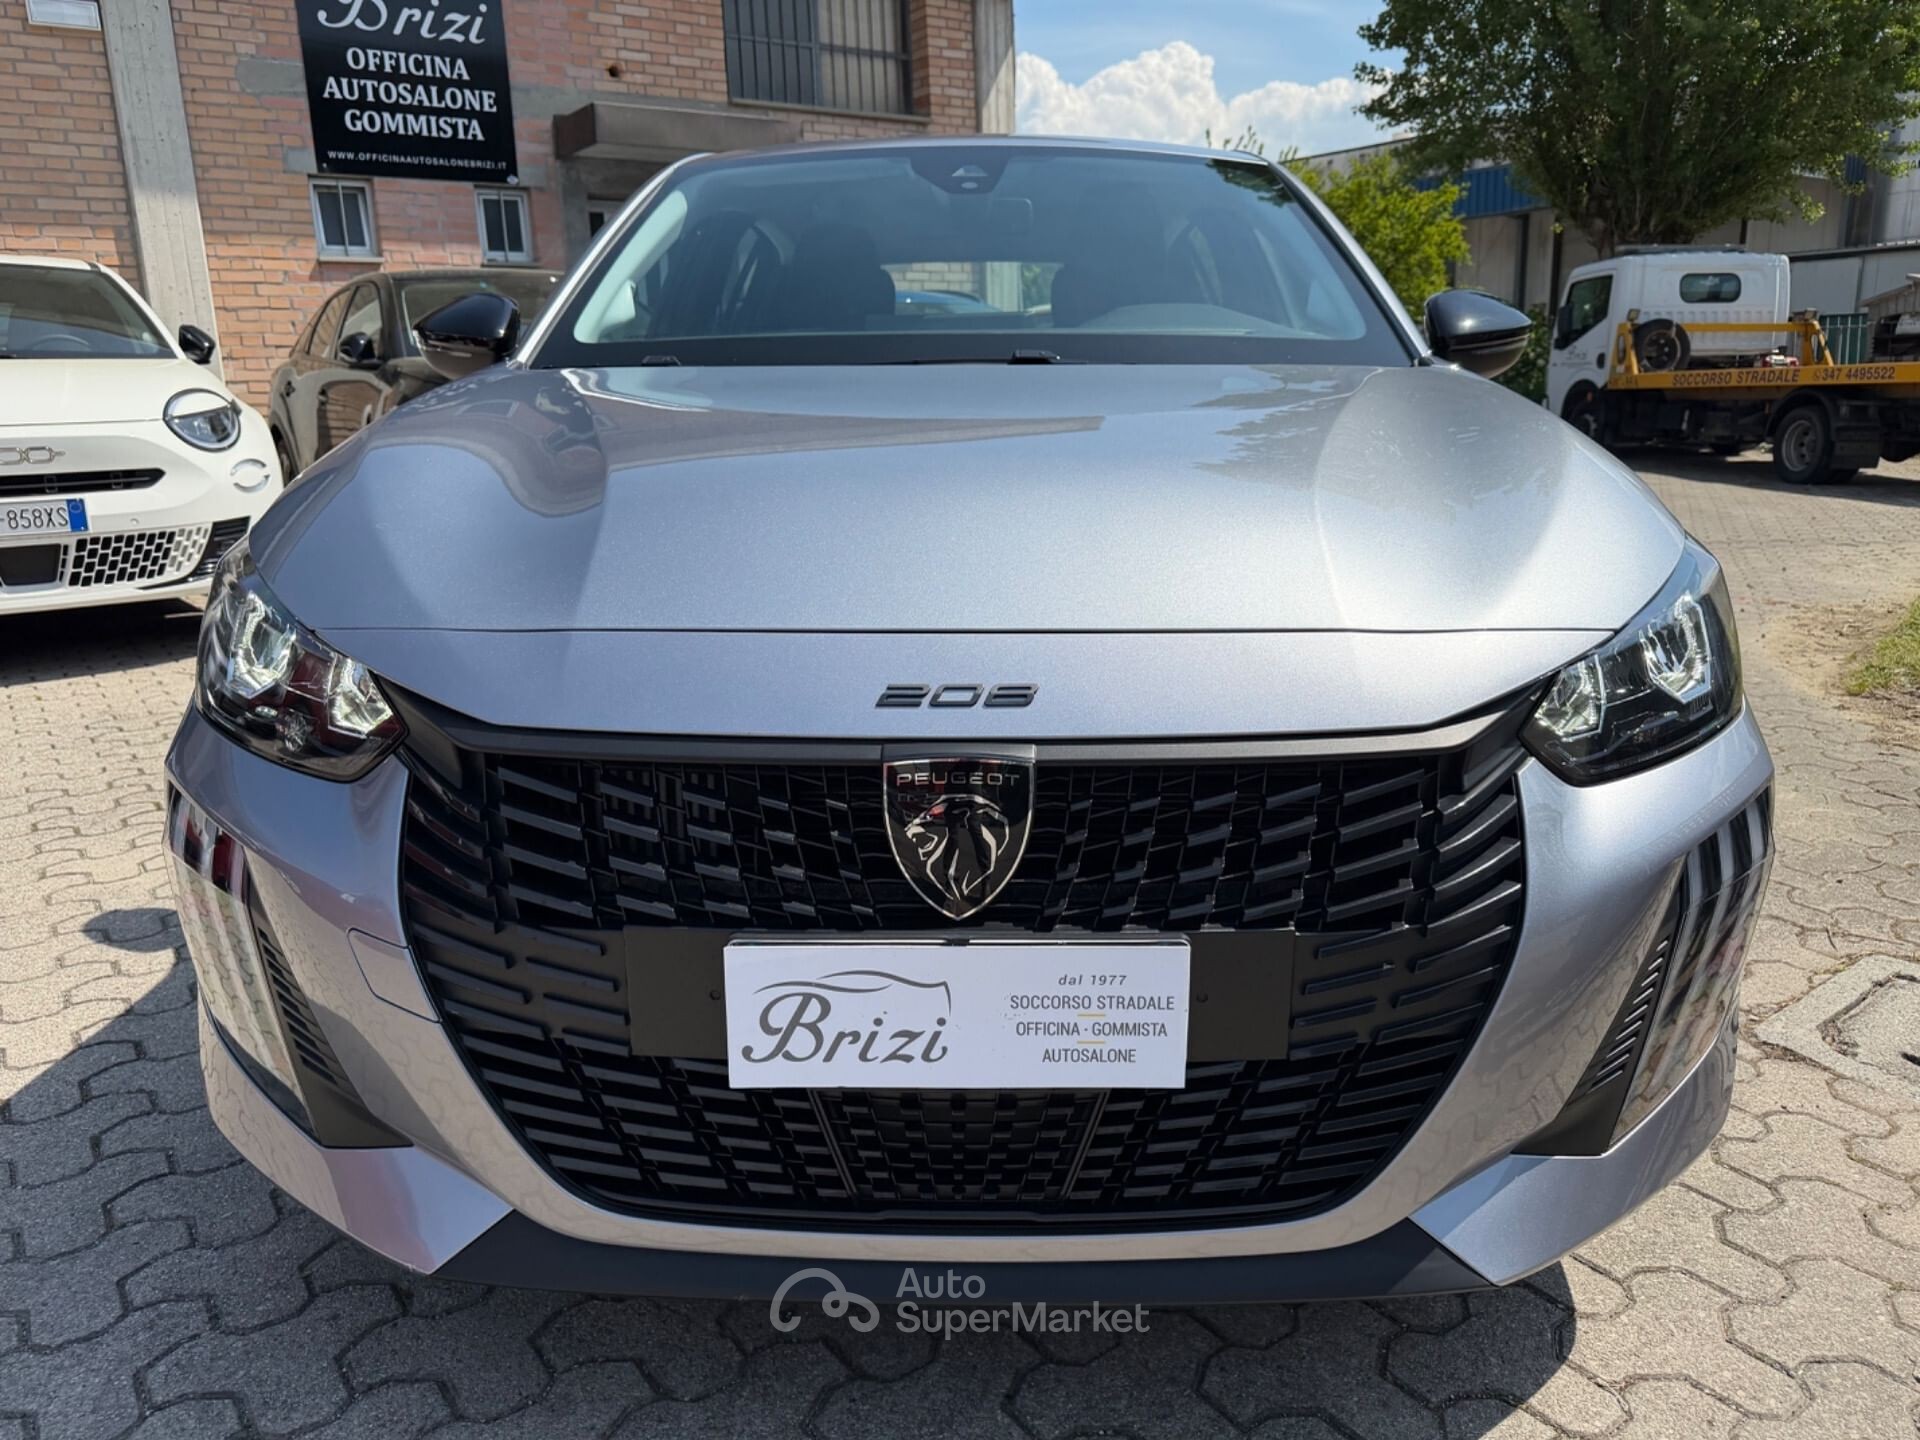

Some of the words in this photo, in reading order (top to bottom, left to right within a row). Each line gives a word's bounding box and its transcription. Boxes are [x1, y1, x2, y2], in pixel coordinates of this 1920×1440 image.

[317, 0, 487, 43] Brizi
[346, 47, 470, 80] OFFICINA
[322, 76, 497, 113] AUTOSALONE
[344, 109, 485, 141] GOMMISTA
[1672, 371, 1732, 387] SOCCORSO
[1736, 369, 1800, 384] STRADALE
[1822, 369, 1842, 381] 347
[1846, 367, 1896, 380] 4495522
[7, 506, 69, 529] 858XS
[875, 684, 1040, 708] 208
[896, 772, 1020, 786] PEUGEOT
[1058, 974, 1083, 986] dal
[1091, 974, 1127, 986] 1977
[1010, 995, 1092, 1010] SOCCORSO
[1096, 995, 1175, 1010] STRADALE
[741, 992, 949, 1064] Brizi
[1015, 1021, 1081, 1036] OFFICINA
[1091, 1021, 1168, 1037] GOMMISTA
[1042, 1048, 1136, 1063] AUTOSALONE
